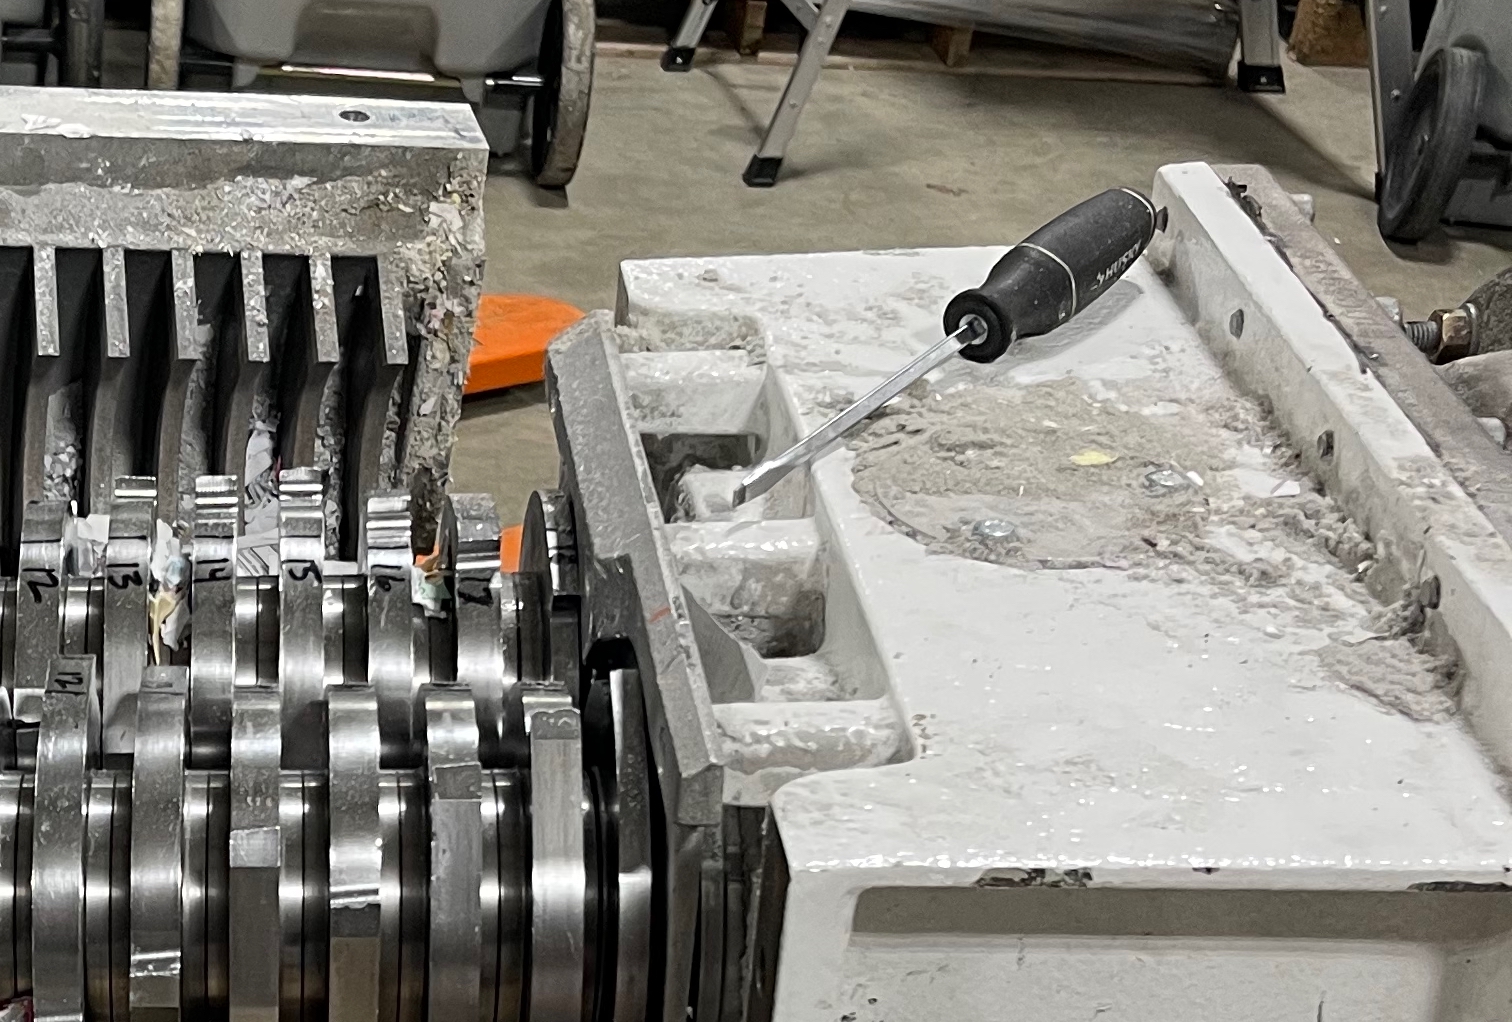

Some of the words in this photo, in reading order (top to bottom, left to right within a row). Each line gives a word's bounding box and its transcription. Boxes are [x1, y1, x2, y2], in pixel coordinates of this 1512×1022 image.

[106, 563, 143, 590] 13
[193, 557, 231, 584] 14
[281, 559, 323, 584] 15
[22, 567, 59, 603] 12
